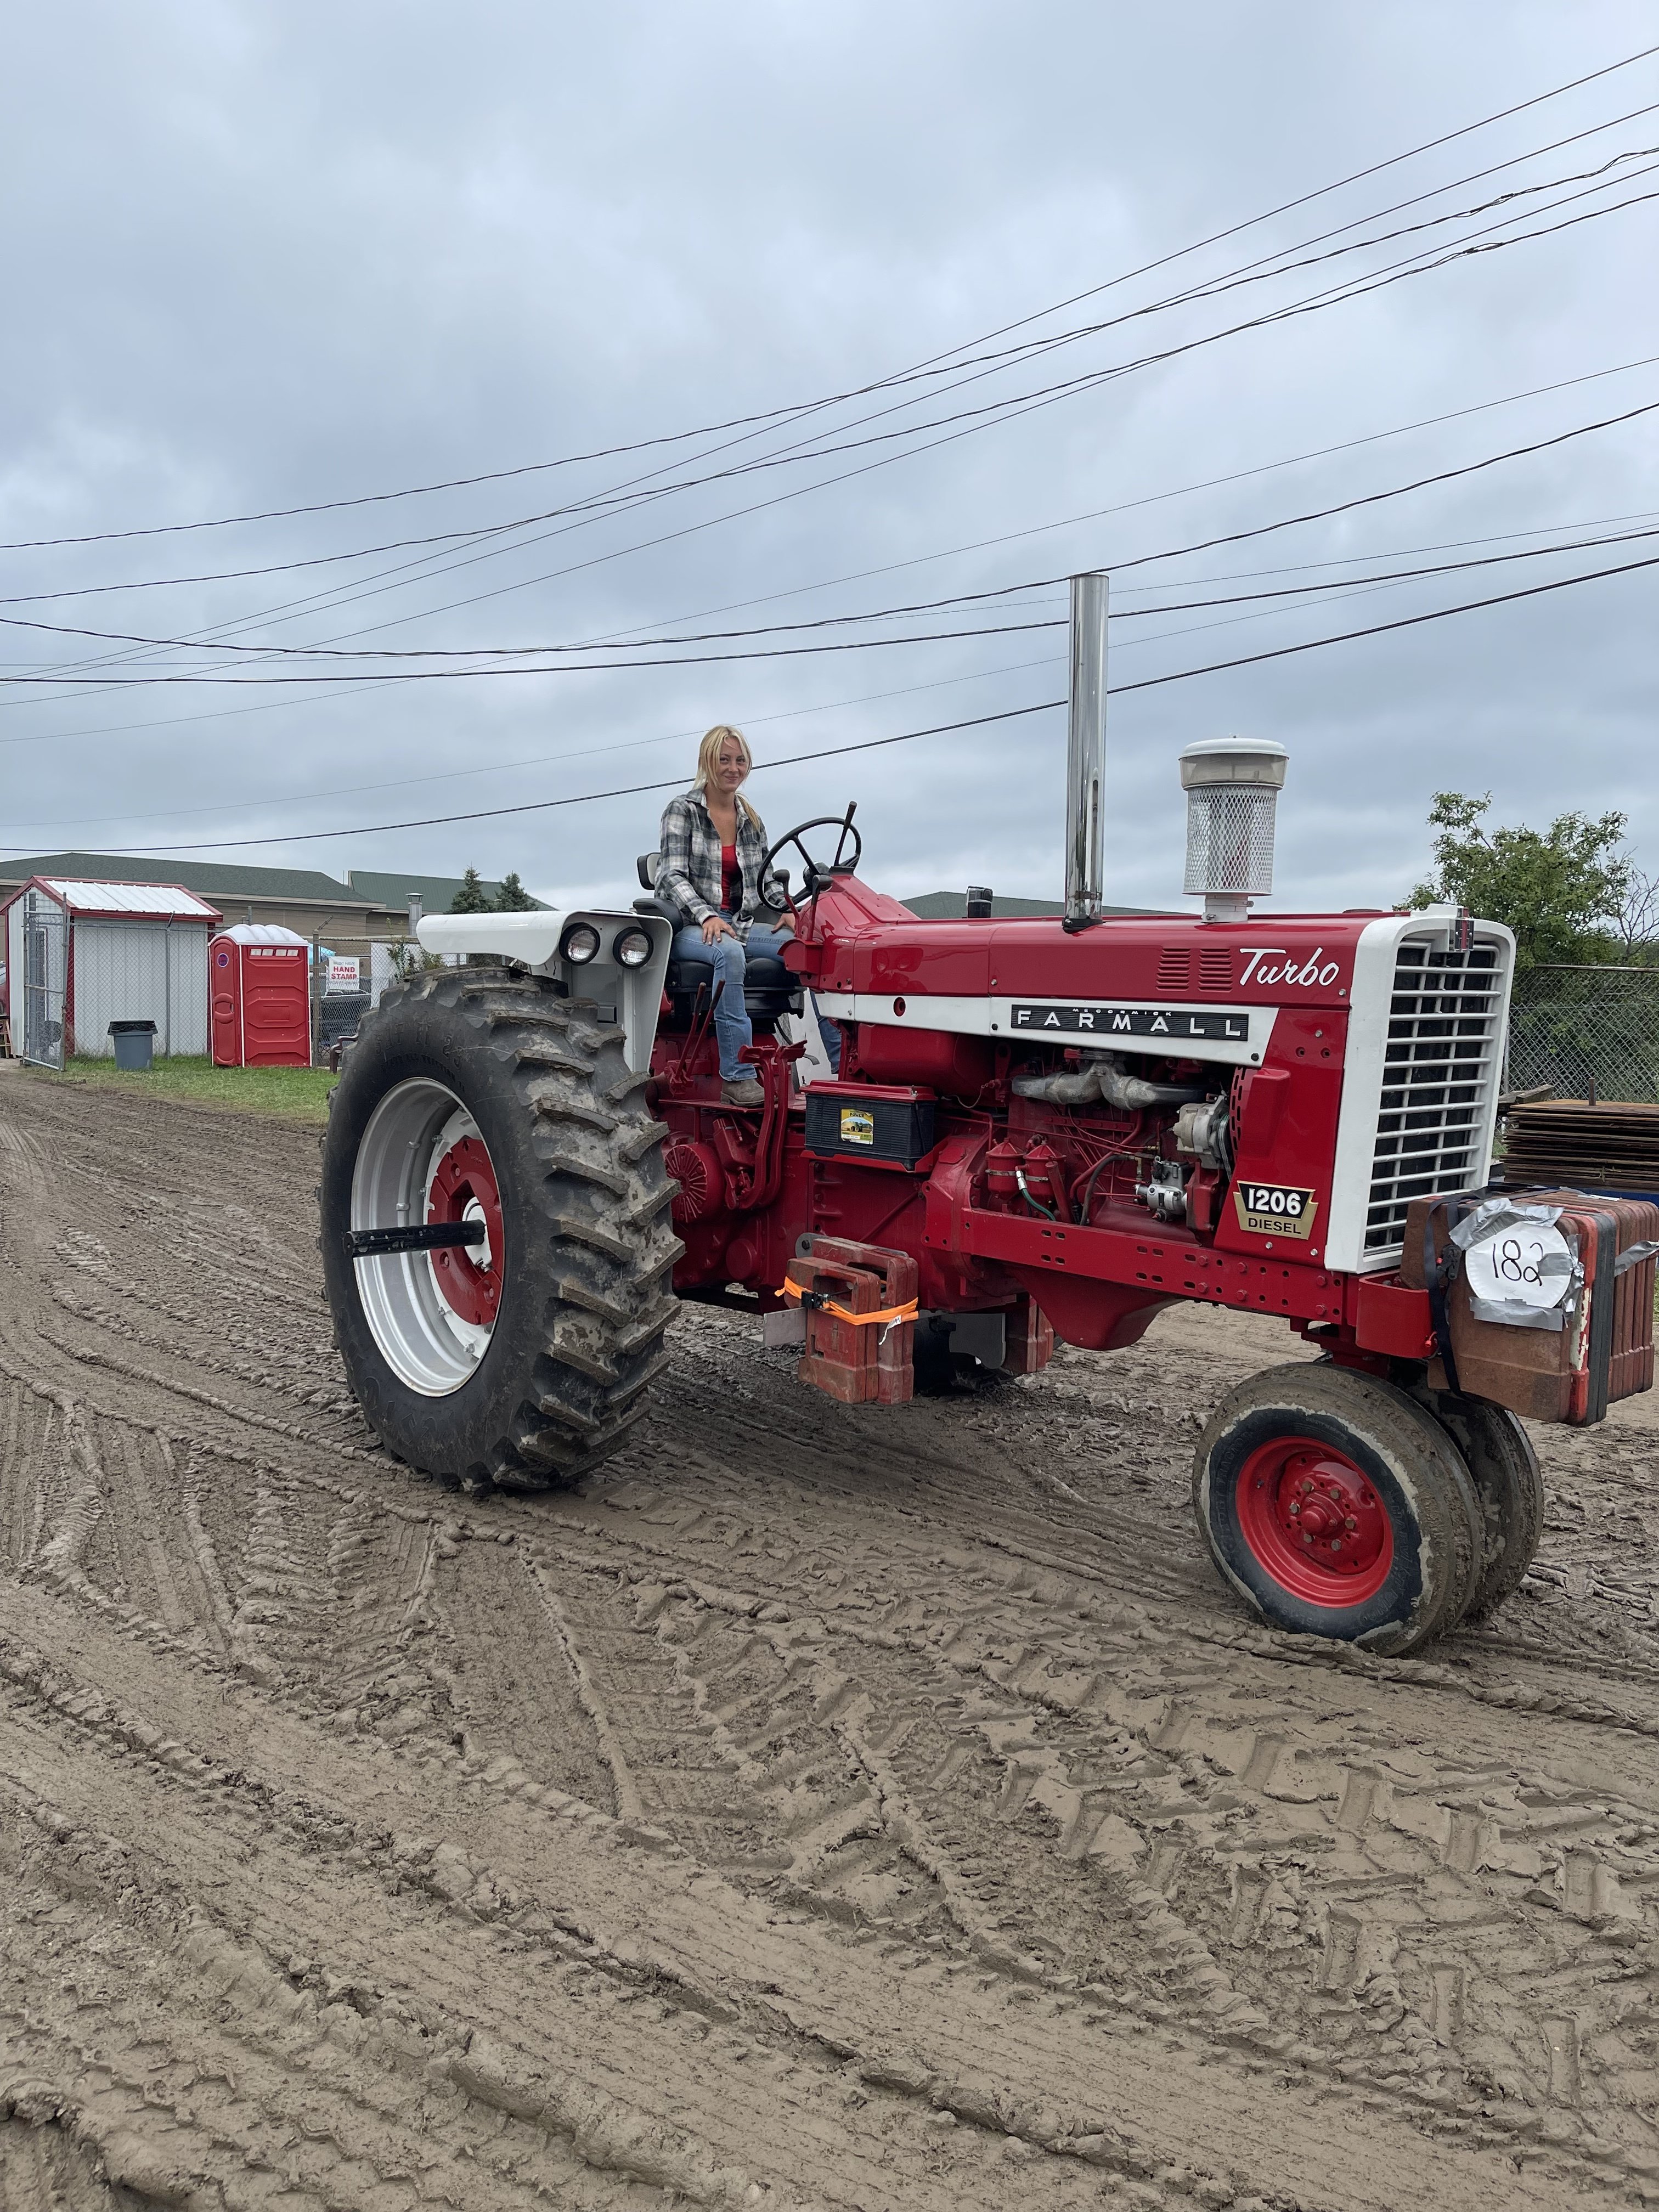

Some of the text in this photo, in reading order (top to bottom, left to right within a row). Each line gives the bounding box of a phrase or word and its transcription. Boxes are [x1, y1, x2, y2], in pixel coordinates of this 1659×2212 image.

[1239, 947, 1340, 986] Turbo
[1017, 1009, 1241, 1037] FARMALL
[1248, 1188, 1301, 1215] 1206
[1248, 1217, 1301, 1234] DIESEL
[1492, 1239, 1543, 1286] 182
